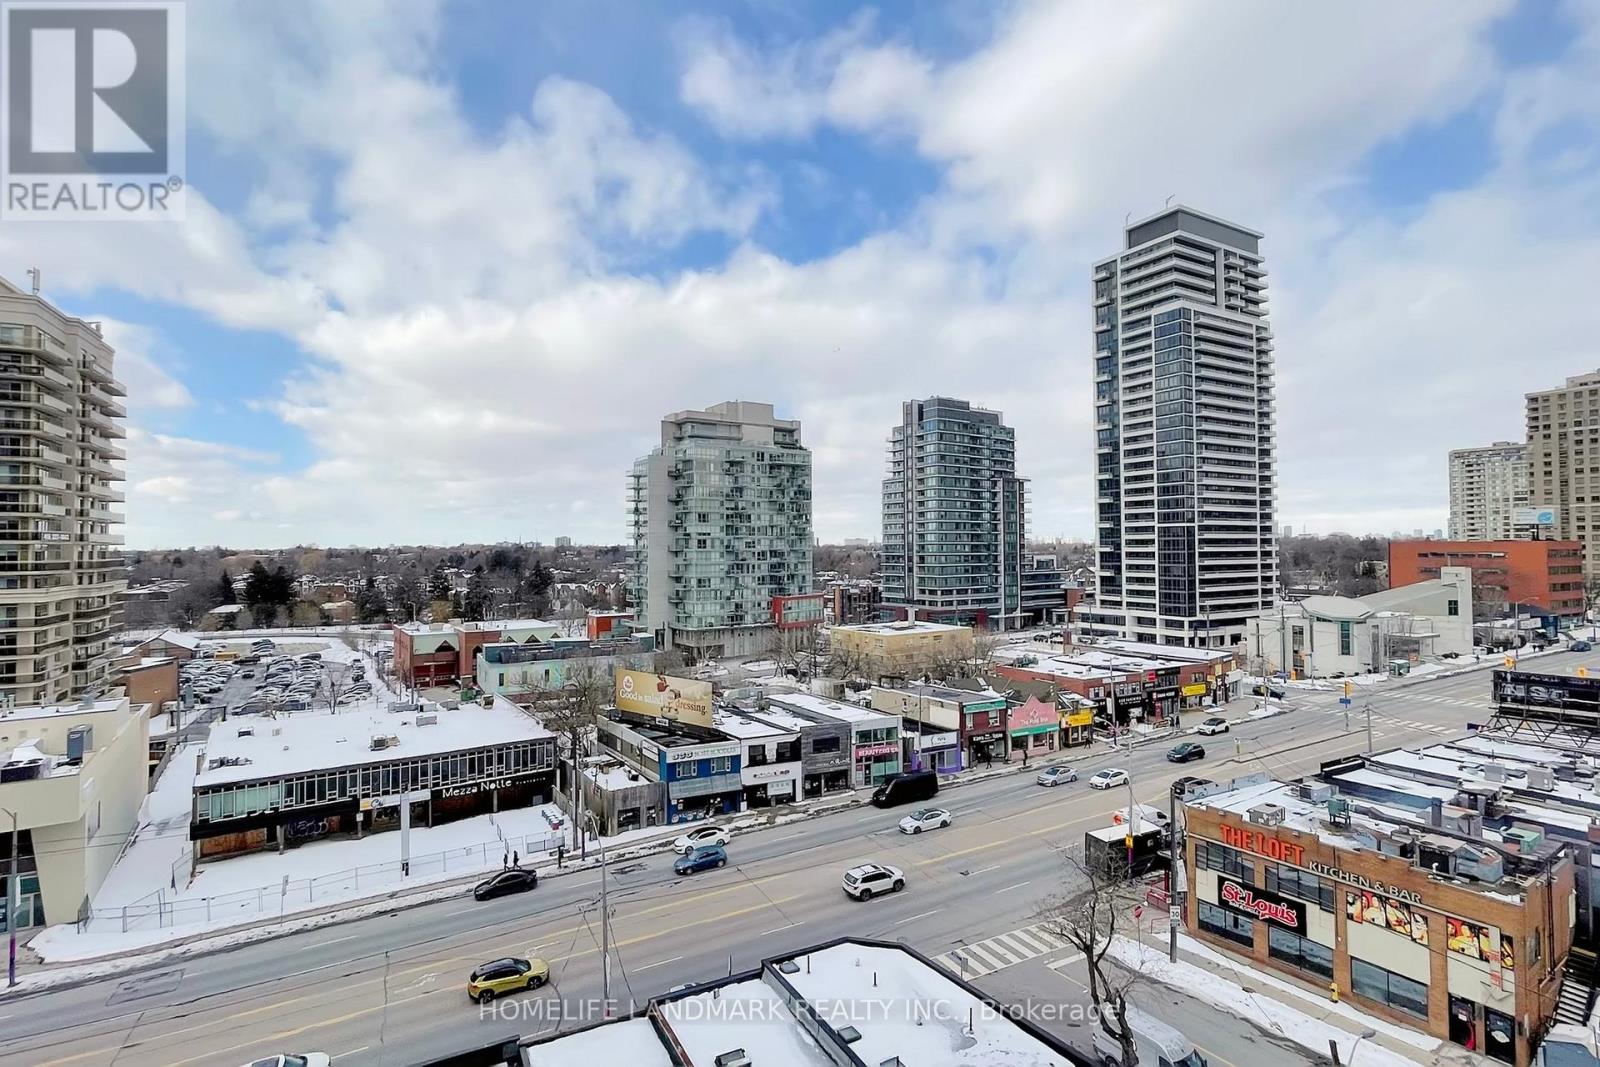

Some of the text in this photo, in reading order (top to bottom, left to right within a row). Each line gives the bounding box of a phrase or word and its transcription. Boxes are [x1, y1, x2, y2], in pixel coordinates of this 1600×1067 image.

[620, 689, 638, 700] Good
[442, 787, 478, 798] Mezza
[1220, 824, 1304, 865] THE LOFT
[1309, 860, 1422, 903] KITCHEN & BAR
[1244, 891, 1298, 927] Louis
